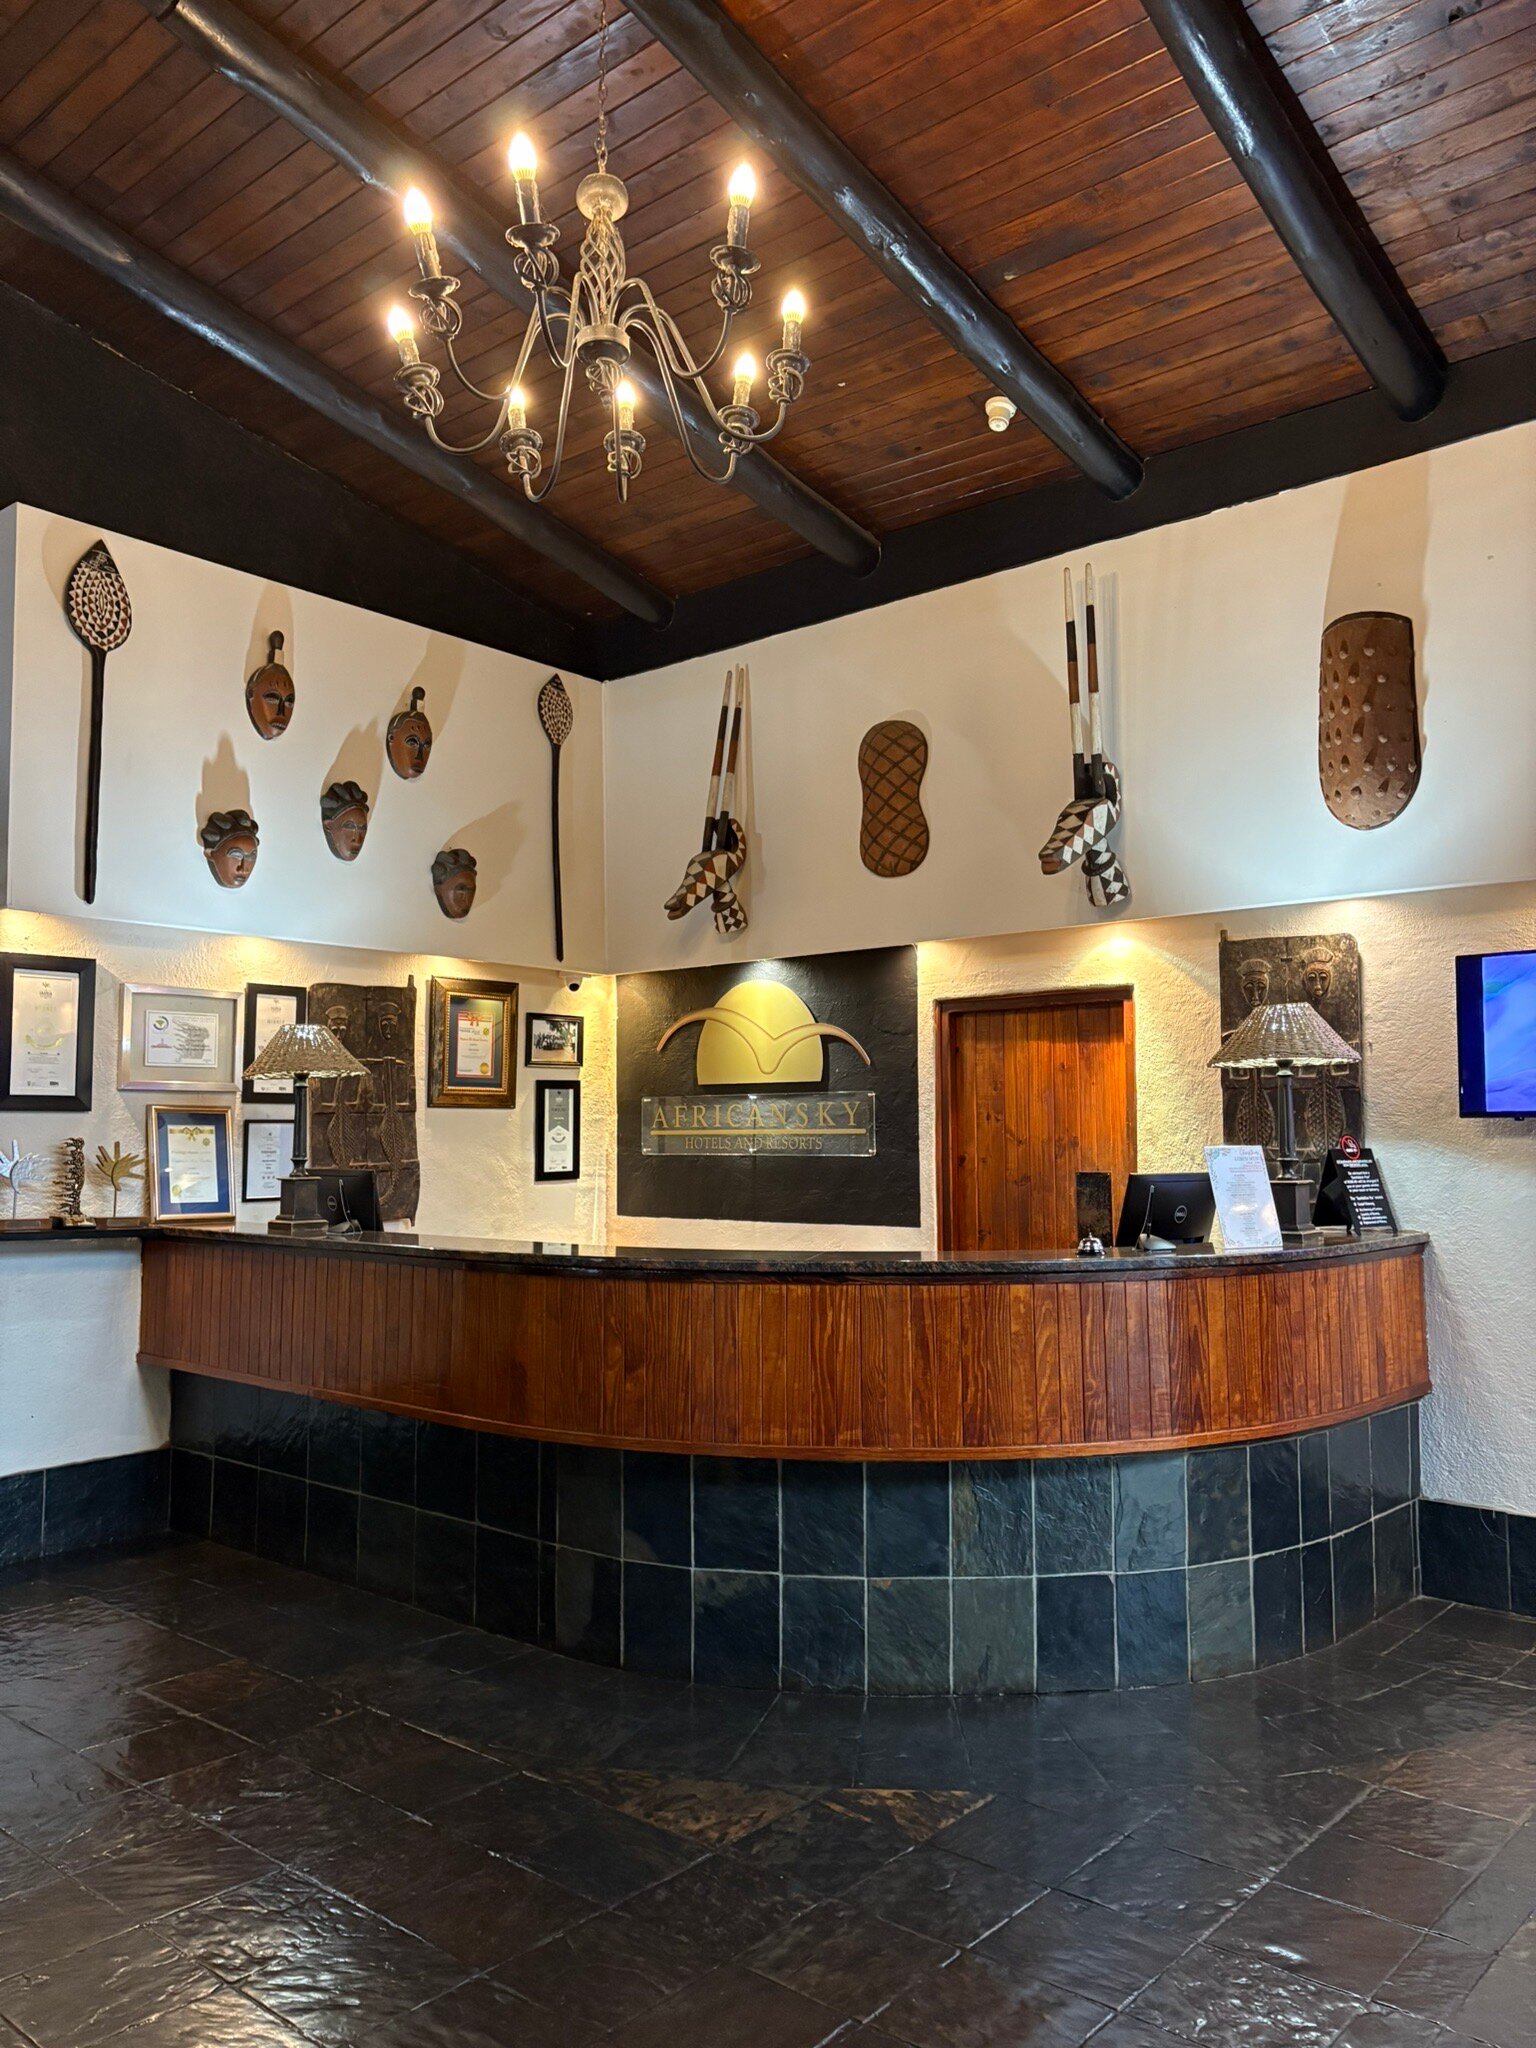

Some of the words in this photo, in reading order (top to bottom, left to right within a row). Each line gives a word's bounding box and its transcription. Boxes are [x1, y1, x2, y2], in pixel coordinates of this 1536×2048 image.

[685, 1136, 732, 1149] HOTELS
[733, 1136, 763, 1149] AND
[766, 1136, 823, 1149] RESORTS
